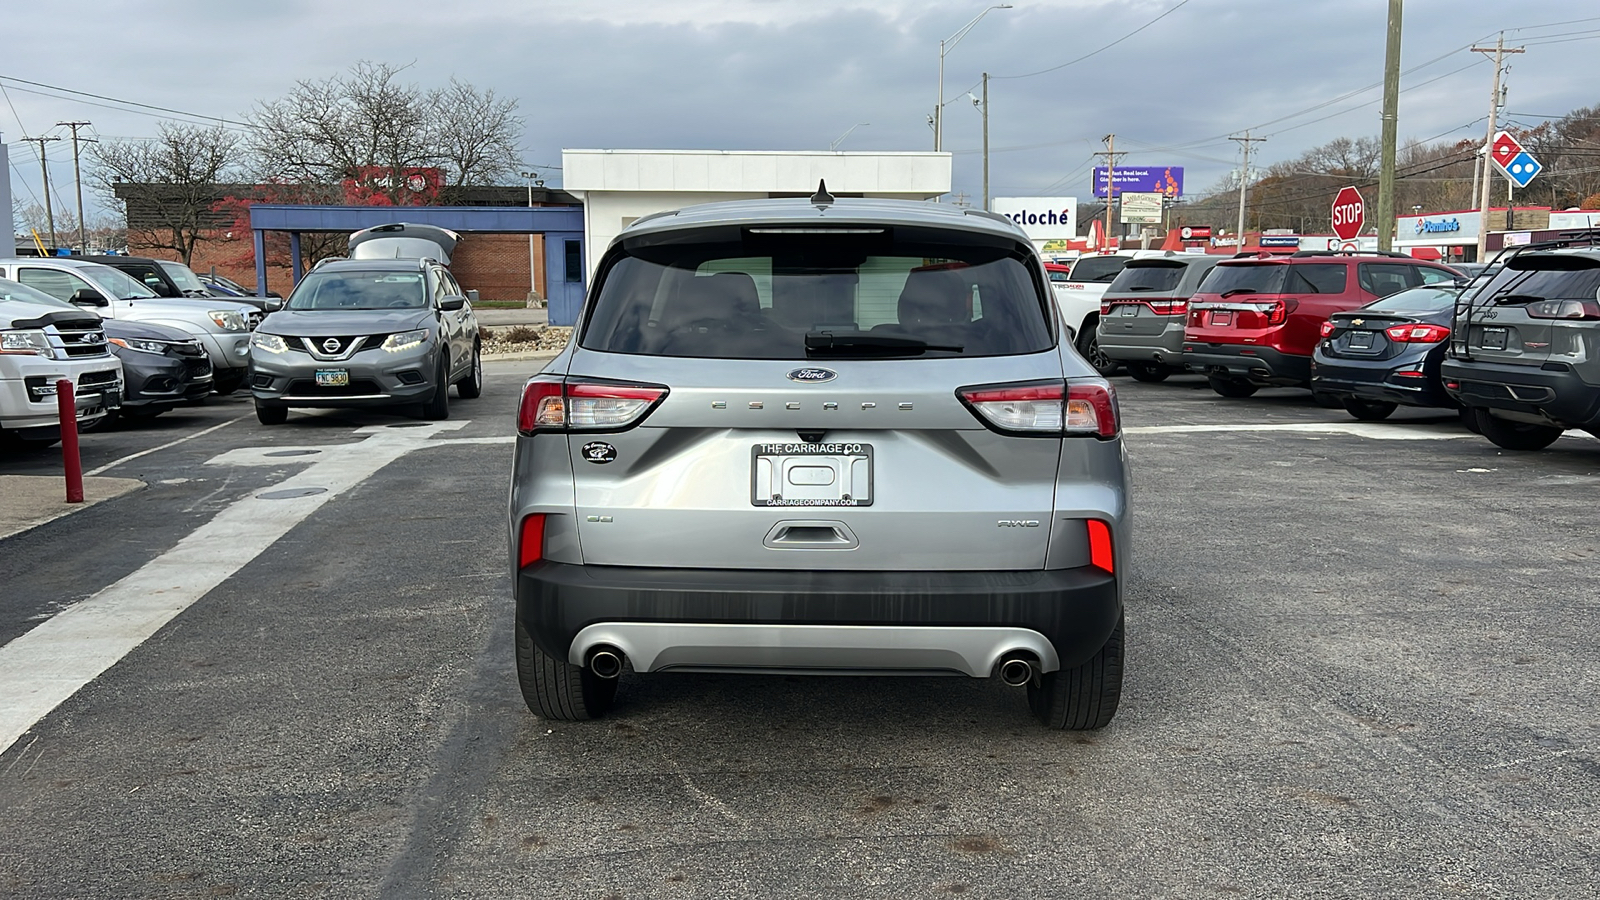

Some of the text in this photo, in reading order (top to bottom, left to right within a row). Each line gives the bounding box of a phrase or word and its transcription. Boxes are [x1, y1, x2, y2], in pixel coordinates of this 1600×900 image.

[1334, 202, 1362, 225] STOP
[1424, 218, 1459, 232] Domino's
[318, 373, 330, 382] FNC
[798, 369, 827, 379] Ford
[711, 400, 914, 411] ESCAPE
[760, 444, 864, 454] THE CARRIAGE CO.
[997, 519, 1040, 528] AWD
